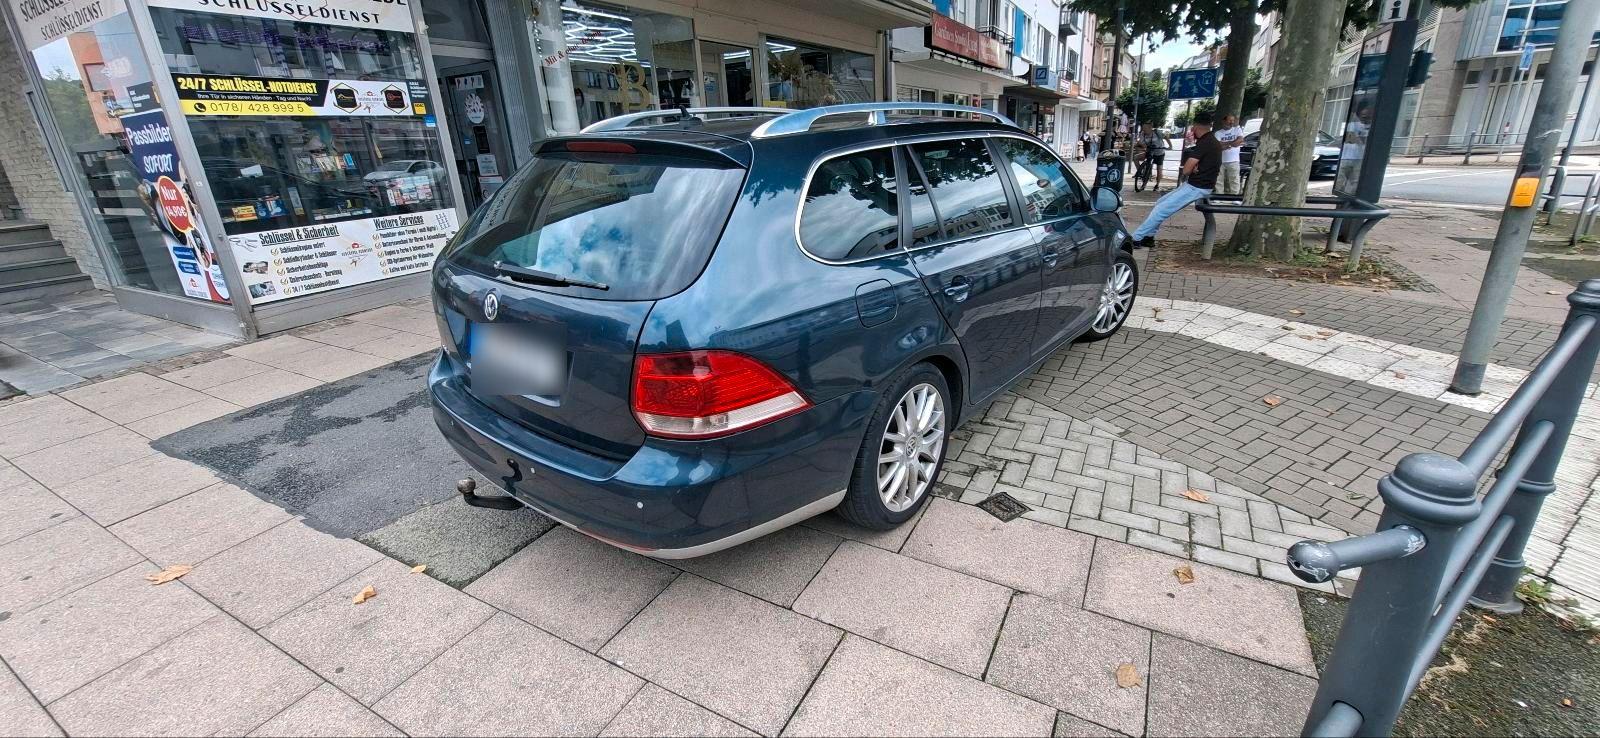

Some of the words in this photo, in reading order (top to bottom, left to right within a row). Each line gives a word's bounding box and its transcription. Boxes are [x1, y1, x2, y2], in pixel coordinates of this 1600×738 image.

[40, 1, 104, 41] SCHLÜSSELDIENST
[544, 55, 558, 65] Mit
[177, 77, 206, 90] 24/7
[209, 77, 318, 94] SCHLÜSSEL-NOTDIENST
[248, 103, 270, 113] 428
[272, 103, 294, 113] 999
[297, 103, 305, 113] 5
[125, 122, 173, 146] Passbilder
[143, 153, 174, 174] SOFORT
[161, 185, 178, 201] Nur
[373, 218, 399, 230] Weitere
[399, 215, 424, 226] Services
[258, 230, 295, 245] Schlüssel
[296, 228, 303, 240] &
[303, 224, 340, 239] Sicherheit
